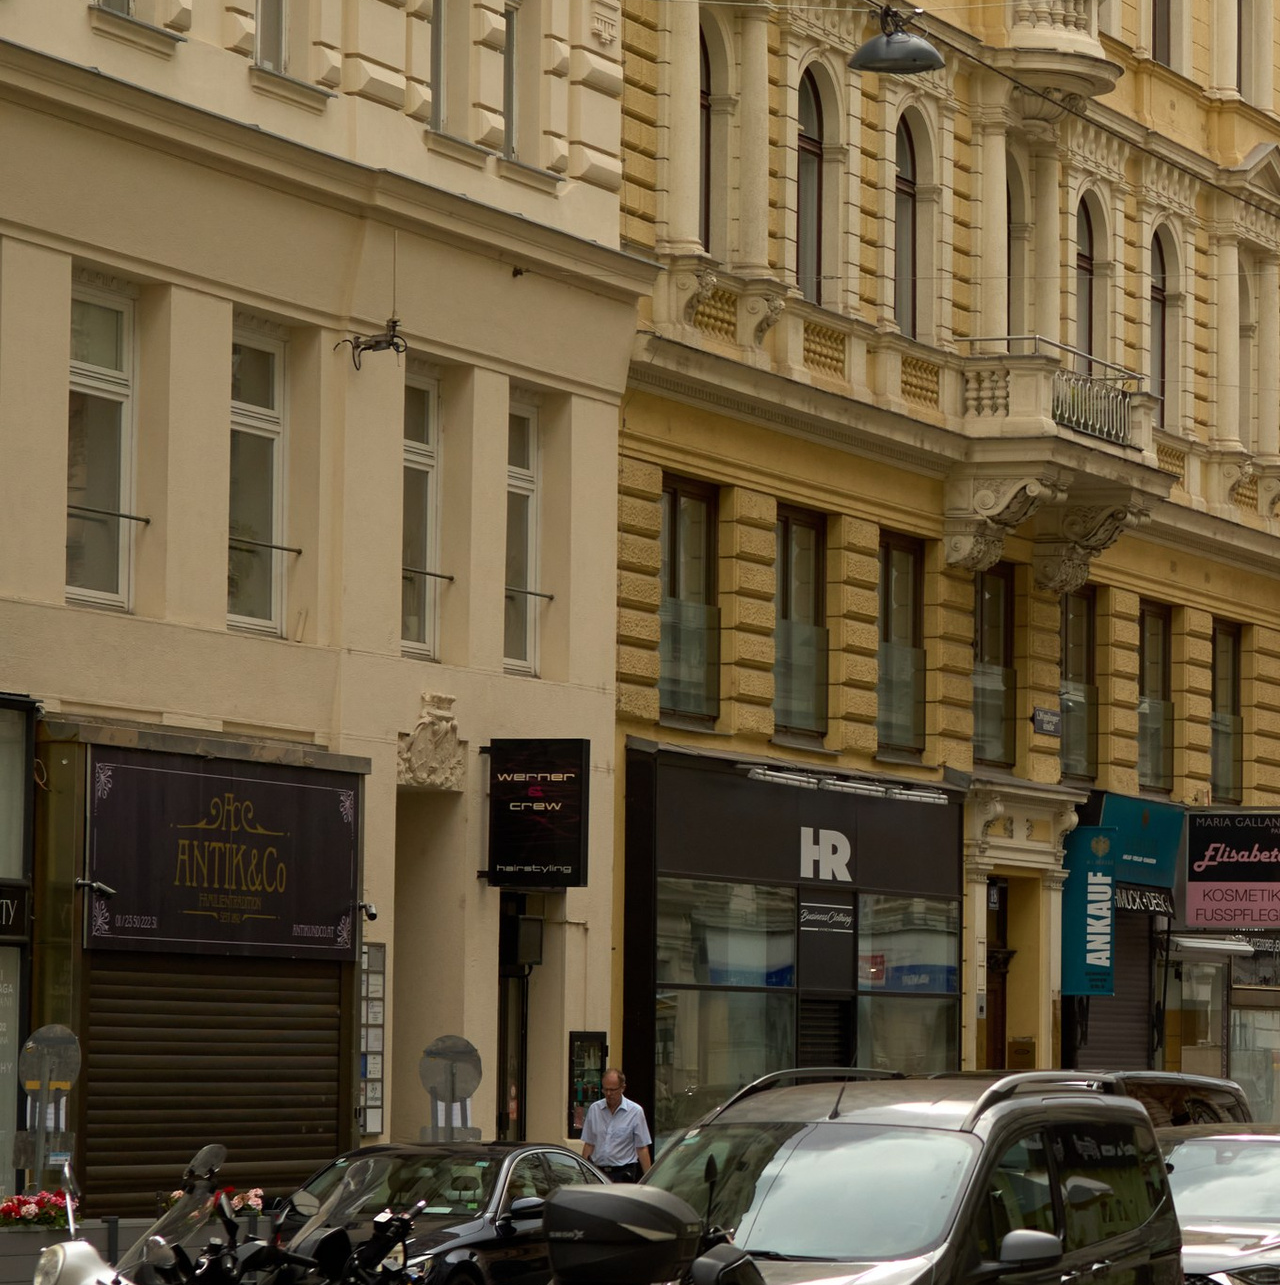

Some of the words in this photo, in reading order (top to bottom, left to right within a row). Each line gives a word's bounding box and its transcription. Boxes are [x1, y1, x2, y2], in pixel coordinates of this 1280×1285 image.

[497, 773, 575, 781] werner
[509, 802, 562, 810] crew
[1196, 818, 1231, 827] MARIA
[800, 826, 853, 882] HR
[496, 864, 572, 873] hairstyling
[1085, 871, 1112, 967] ANKAUF
